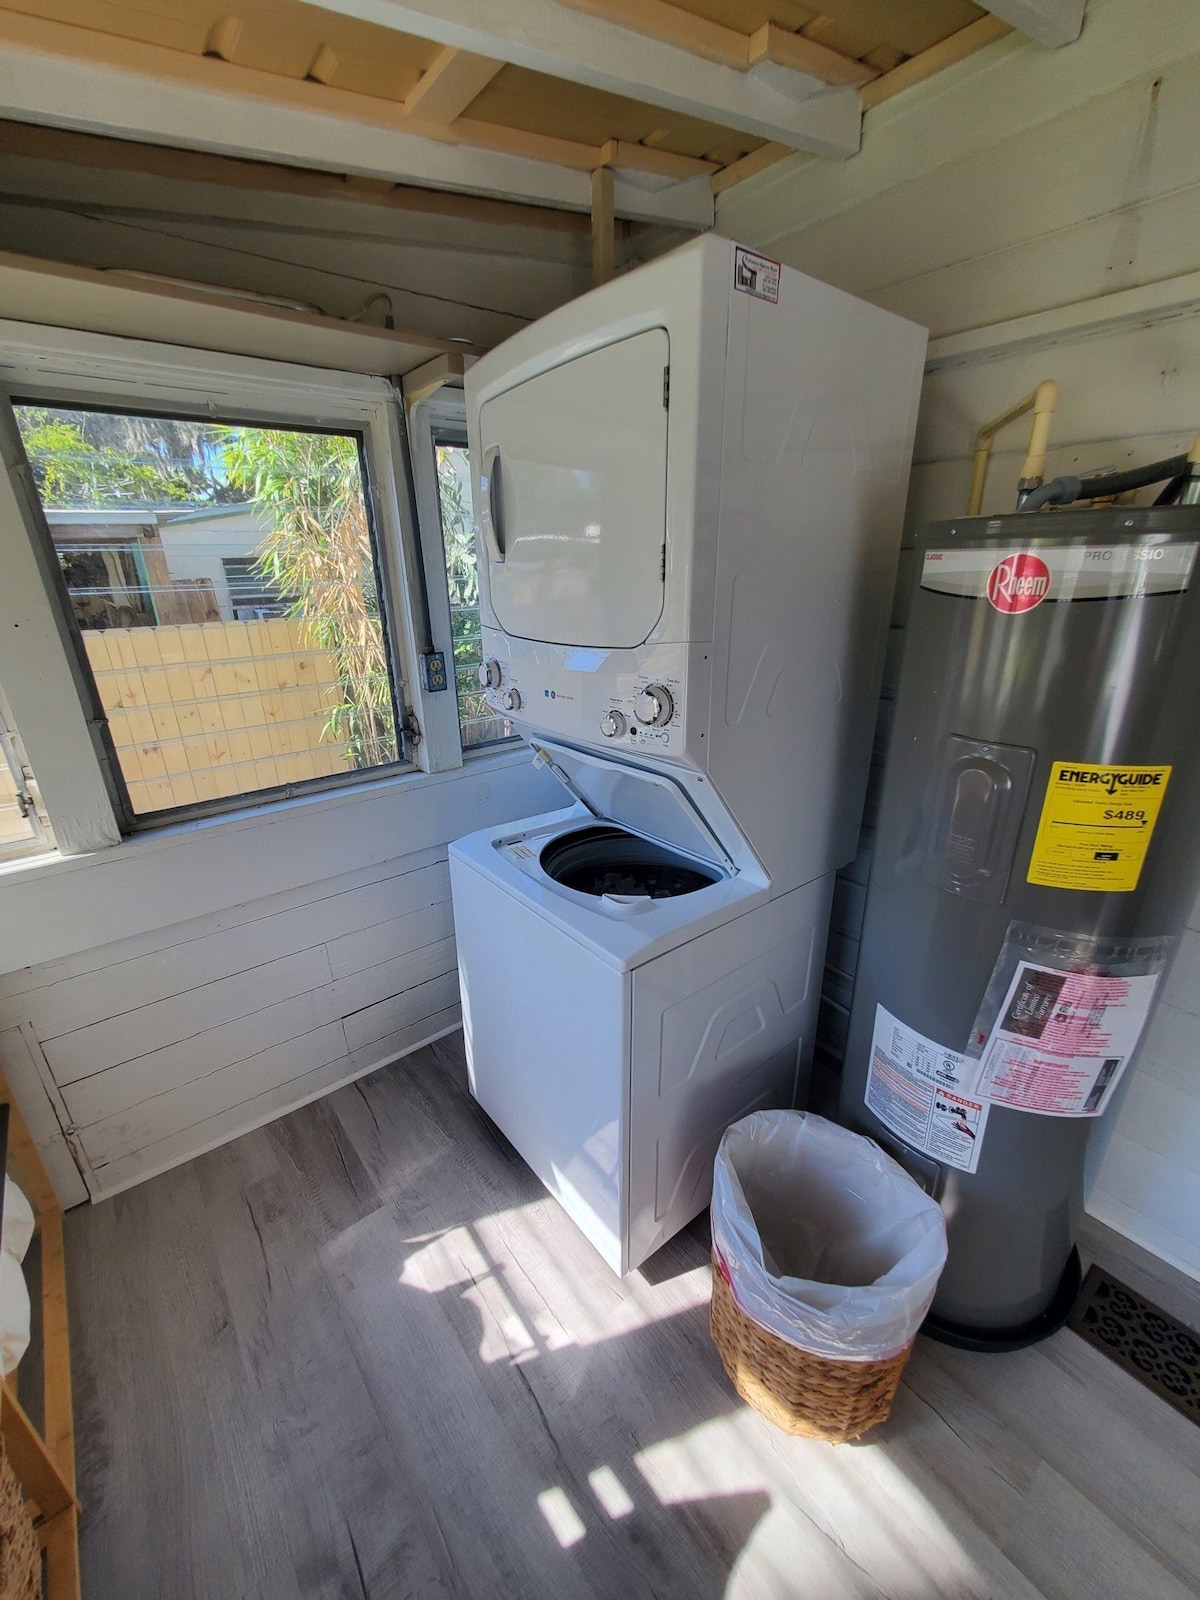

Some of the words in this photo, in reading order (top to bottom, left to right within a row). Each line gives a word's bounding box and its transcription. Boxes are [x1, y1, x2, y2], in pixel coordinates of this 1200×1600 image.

[992, 554, 1048, 604] Rheem
[1058, 769, 1163, 787] ENERGYGUIDE
[1024, 981, 1035, 993] of
[1024, 994, 1041, 1016] Limited
[946, 1093, 981, 1110] DANGER
